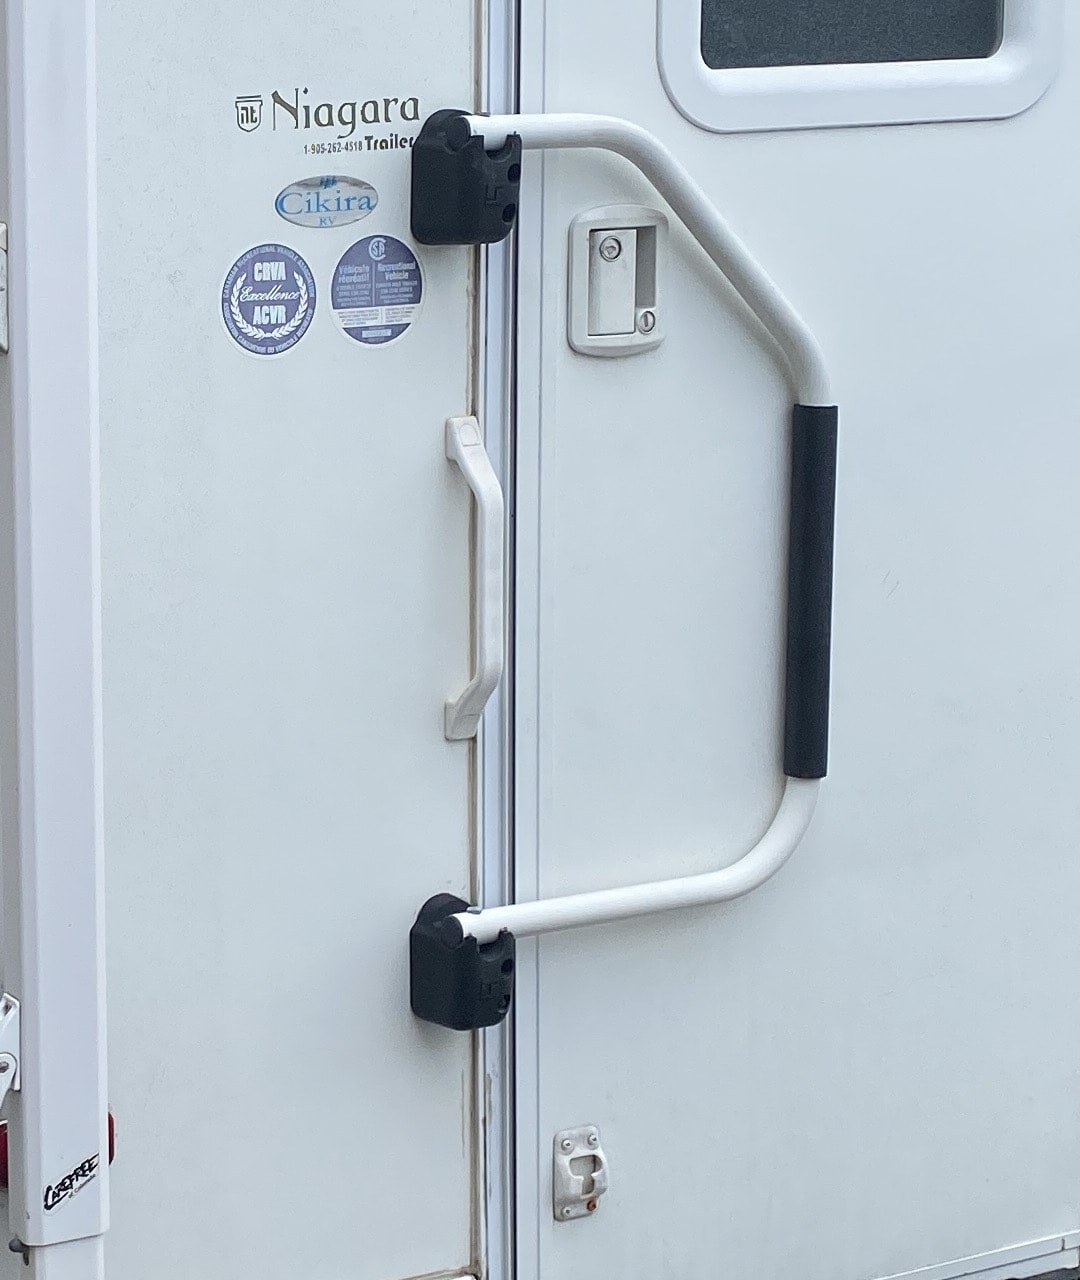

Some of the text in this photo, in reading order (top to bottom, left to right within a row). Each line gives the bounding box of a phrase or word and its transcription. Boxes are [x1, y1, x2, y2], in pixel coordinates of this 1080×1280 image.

[271, 87, 420, 139] Niagara
[278, 190, 374, 216] Cikira
[319, 216, 337, 227] RV
[239, 284, 300, 302] Excellence
